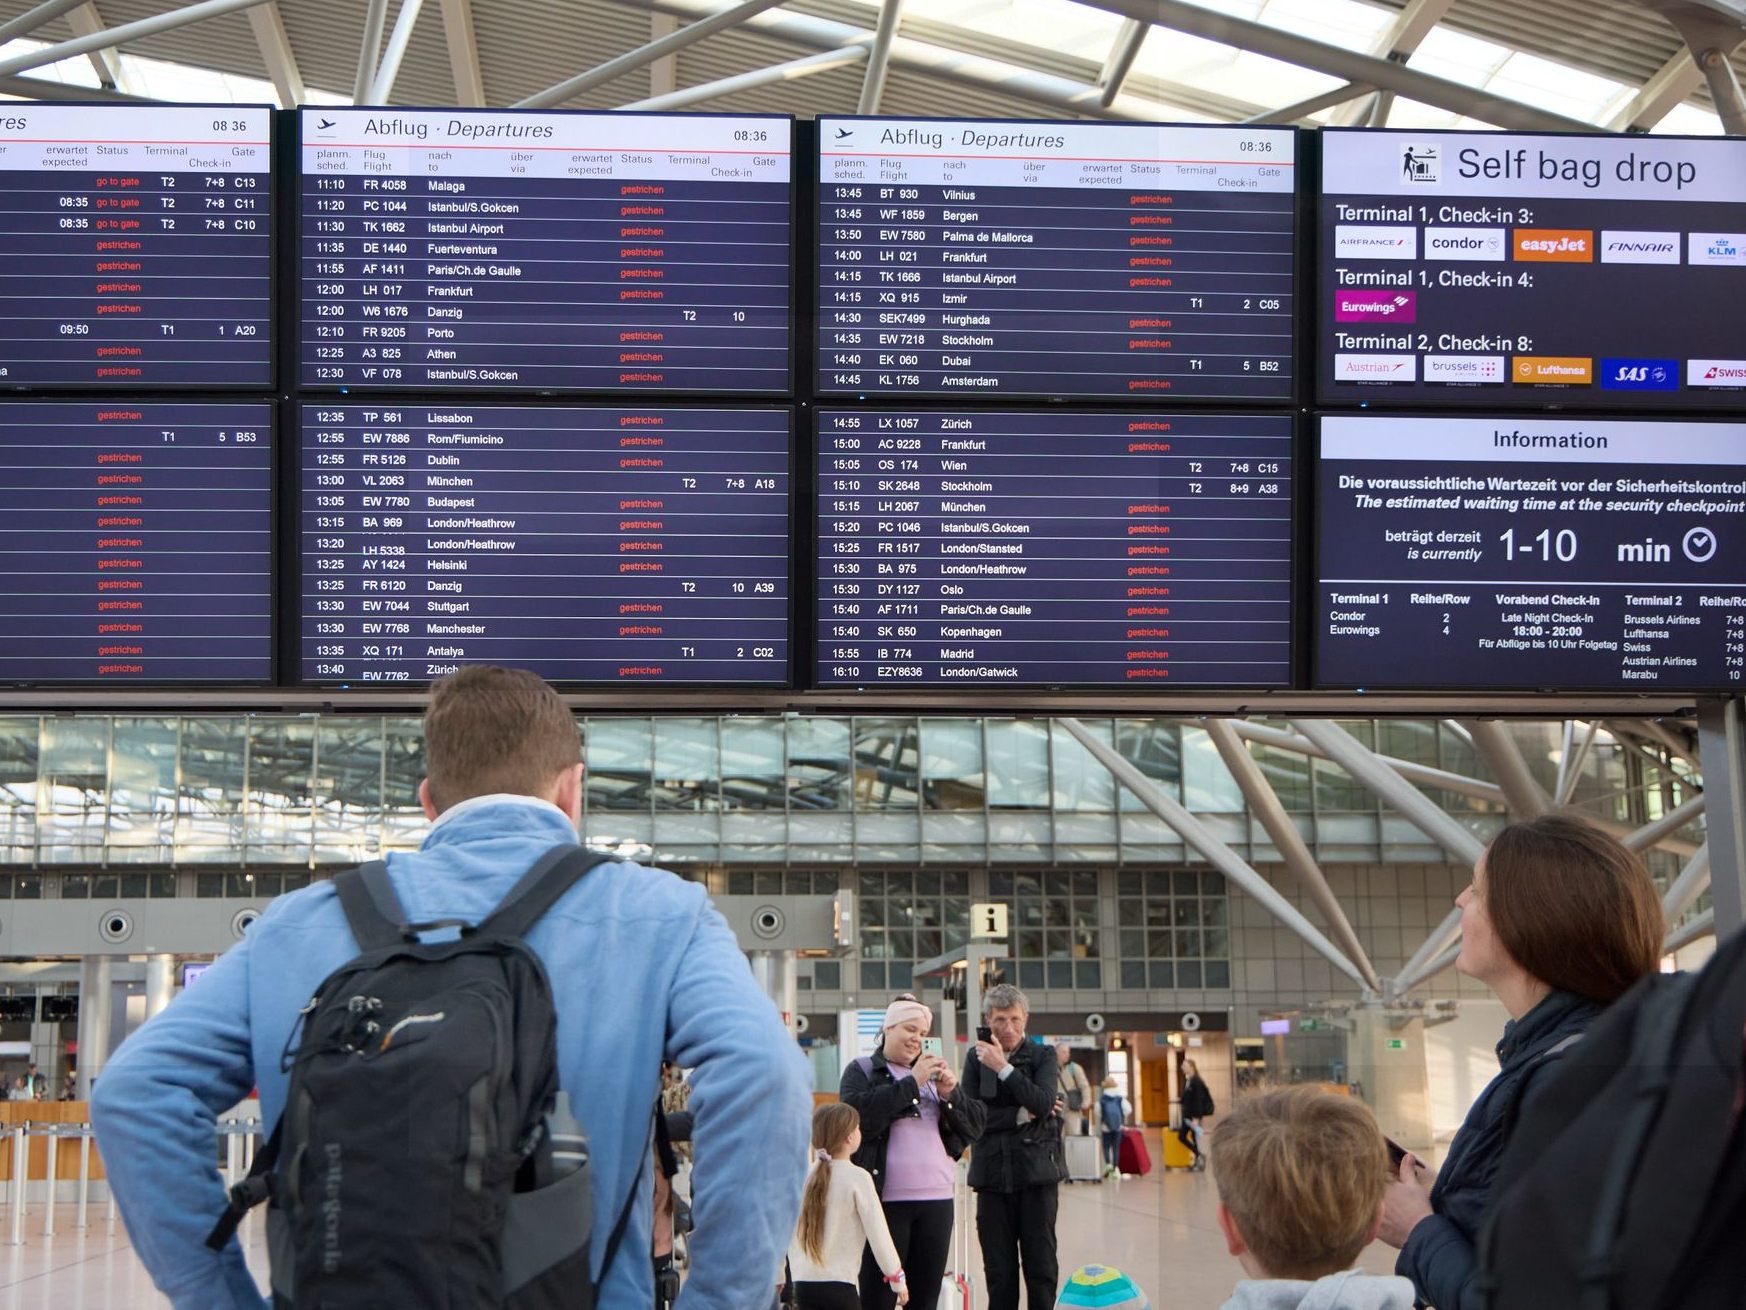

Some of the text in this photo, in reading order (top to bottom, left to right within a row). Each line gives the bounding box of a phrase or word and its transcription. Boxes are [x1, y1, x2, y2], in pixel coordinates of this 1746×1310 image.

[365, 119, 553, 140] Abflug Departures
[734, 131, 766, 141] 08:36
[881, 129, 1064, 149] Abflug Departures
[1240, 142, 1271, 152] 08:36
[1459, 149, 1695, 190] Self bag drop
[96, 177, 255, 187] go to gate T2 7+8 C13
[318, 180, 664, 194] 11:10 FR 4058 Malaga gestrichen
[836, 188, 1172, 204] 13:45 BT 930 Vilnius gestrichen
[1336, 205, 1533, 224] Terminal 1, Check-in 3:
[1433, 237, 1483, 248] condor
[1521, 238, 1586, 254] easyJet
[1609, 243, 1673, 252] FINNAIR
[1336, 269, 1532, 288] Terminal 1, Check-in 4:
[835, 292, 1279, 309] 14:15 XQ 915 Izmir T1 2 C05
[1342, 301, 1396, 315] Eurowings
[61, 325, 255, 335] 09:50 T1 1 A20
[317, 327, 663, 342] 12:10 FR 9205 Porto gestrichen
[1335, 333, 1532, 352] Terminal 2, Check-in 8:
[1346, 362, 1389, 372] Austrian
[1433, 362, 1477, 371] brussels
[1538, 365, 1585, 375] Lufthansa
[1615, 367, 1648, 381] SAS
[162, 432, 256, 441] T1 5 B53
[1495, 431, 1607, 448] Information
[317, 455, 663, 467] 12:55 FR 5126 Dublin gestrichen
[317, 476, 774, 488] 13:00 VL 2063 München T2 7+8 A18
[834, 481, 1277, 493] 15:10 SK 2648 Stockholm T2 8+9 A38
[1339, 476, 1363, 488] Die
[1367, 477, 1485, 490] voraussichtliche
[1487, 477, 1557, 491] Wartezeit
[1561, 482, 1585, 491] vor
[1588, 479, 1612, 491] der
[1355, 495, 1745, 515] The estimated waiting time at the security checkpoint
[1386, 530, 1481, 544] beträgt derzeit
[1500, 529, 1670, 562] 1-10 min
[1408, 547, 1482, 562] is currently
[1331, 593, 1470, 604] Terminal 1 Reihe/Row
[1496, 595, 1599, 605] Vorabend Check-In
[1625, 595, 1672, 605] Terminal
[1676, 596, 1682, 605] 2
[1330, 611, 1449, 622] Condor 2
[1502, 613, 1593, 624] Late Night Check-In
[1625, 615, 1744, 625] Brussels Airlines 7+8
[1330, 625, 1449, 636] Eurowings 4
[1513, 626, 1543, 636] 18:00
[1552, 626, 1582, 636] 20:00
[1624, 629, 1744, 639] Lufthansa 7+8
[1479, 639, 1617, 650] Für Abflüge bis 10 Uhr Folgetag
[1623, 643, 1743, 652] Swiss 7+8
[1622, 656, 1743, 666] Austrian Airlines 7+8
[833, 667, 1168, 678] 16:10 EZY8636 London/Gatwick gestrichen
[1623, 670, 1740, 679] Marabu 10
